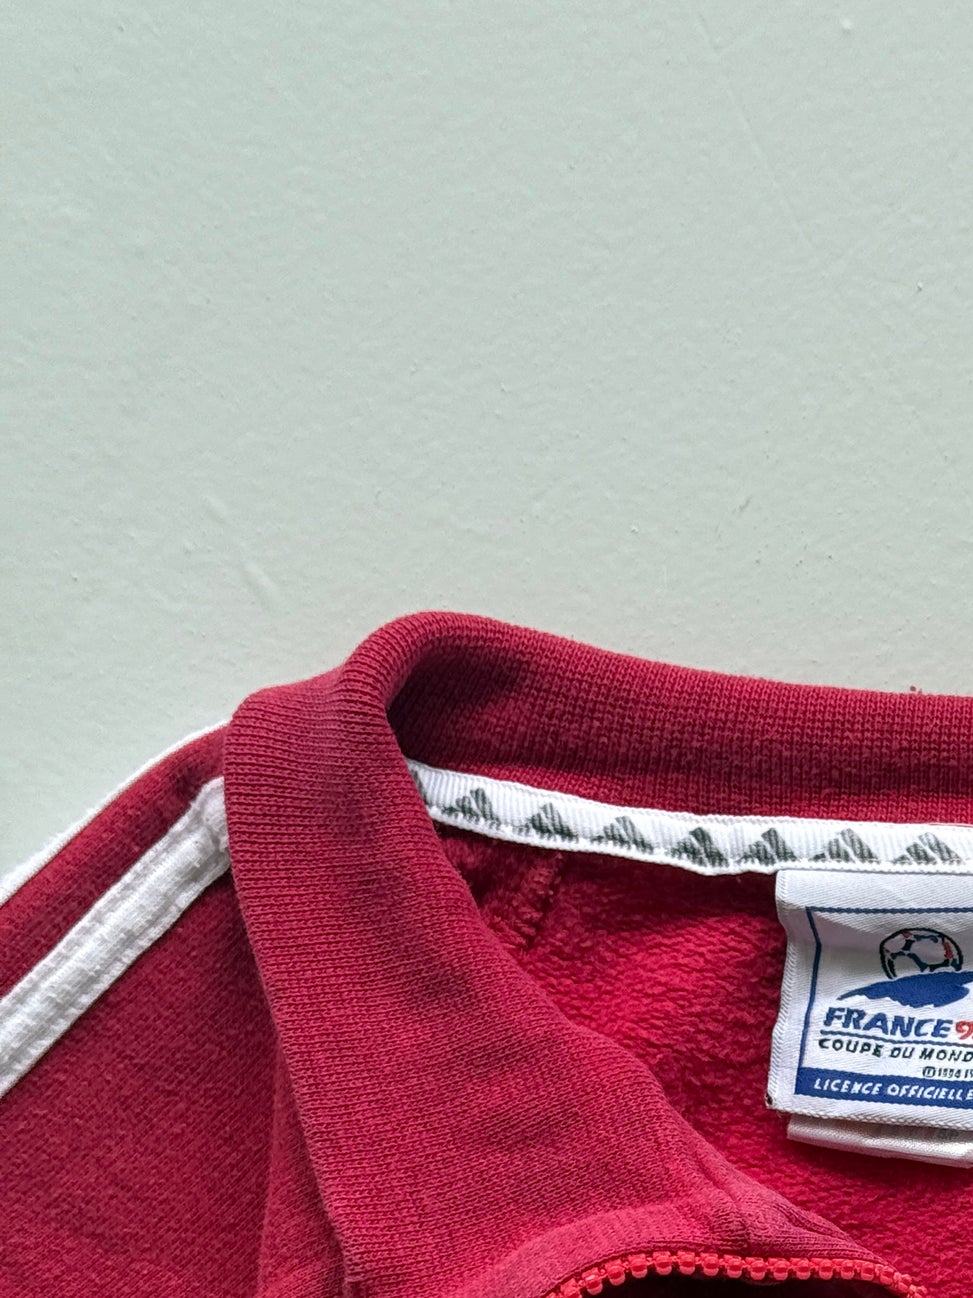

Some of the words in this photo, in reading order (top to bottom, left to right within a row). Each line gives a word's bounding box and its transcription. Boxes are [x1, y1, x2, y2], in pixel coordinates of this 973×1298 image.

[823, 1007, 954, 1039] FRANCE
[818, 1038, 885, 1058] COUPE
[889, 1046, 915, 1059] DU
[813, 1078, 883, 1096] LICENCE
